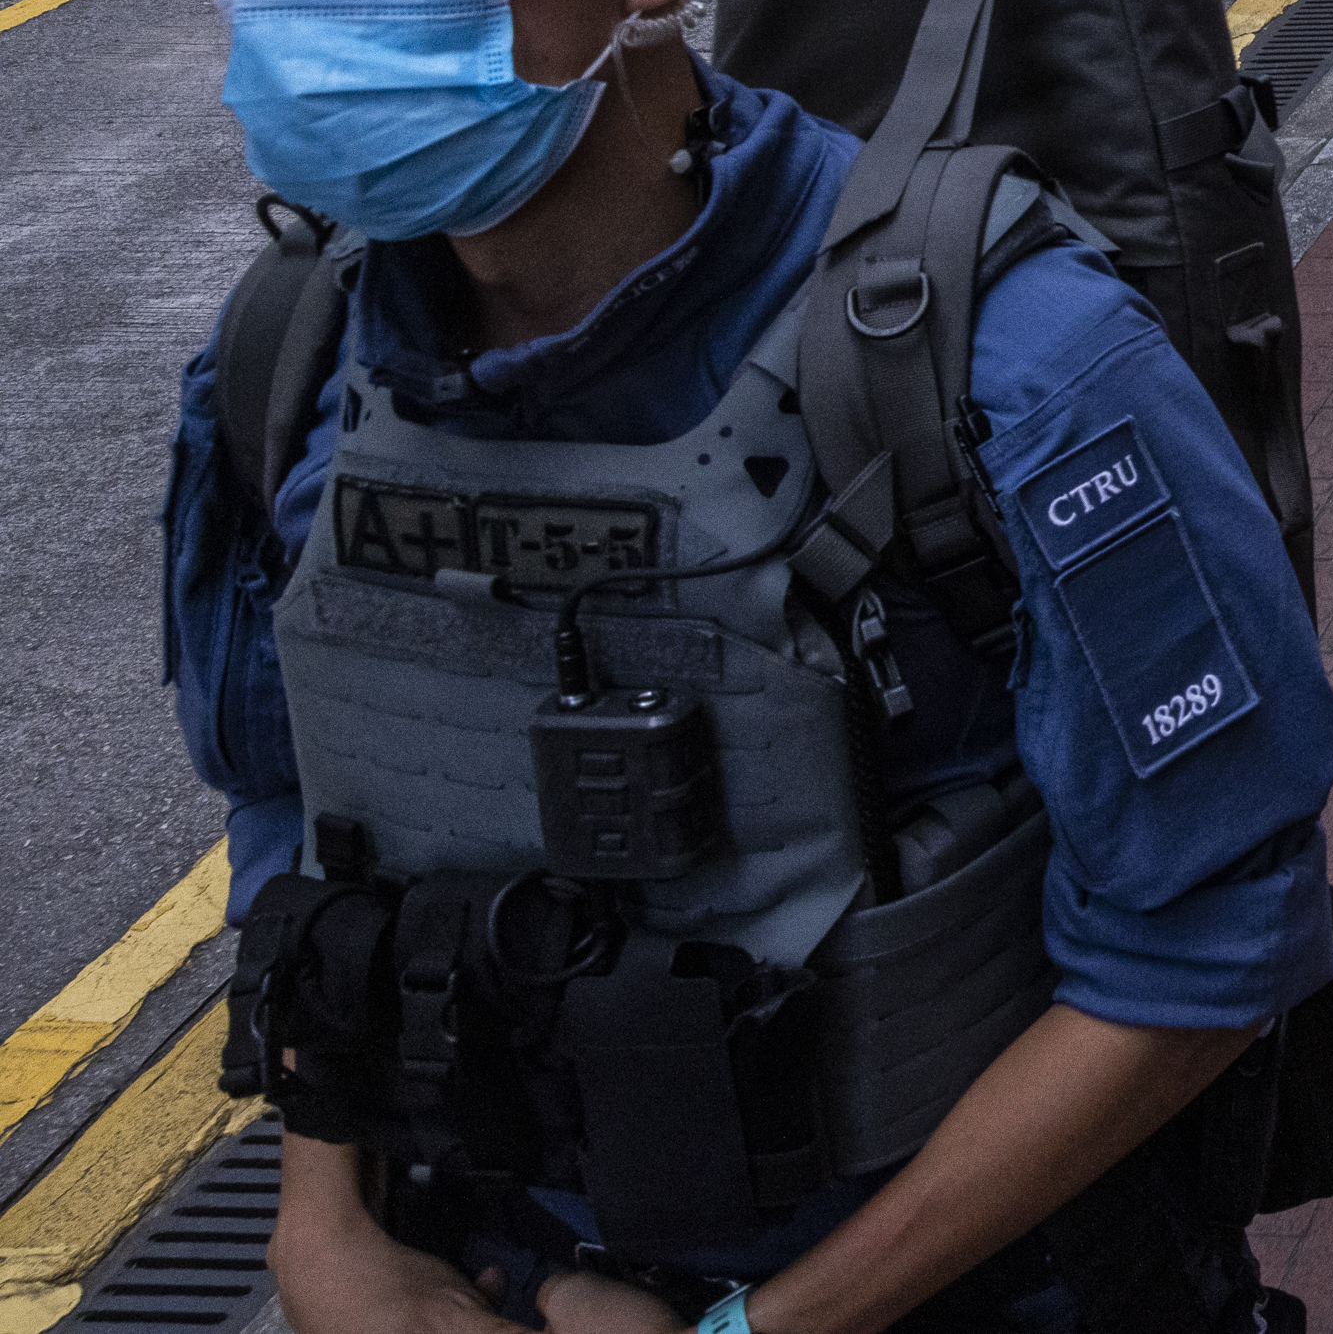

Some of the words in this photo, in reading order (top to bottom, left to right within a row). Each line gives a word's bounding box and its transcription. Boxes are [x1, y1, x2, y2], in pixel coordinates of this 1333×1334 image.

[1047, 455, 1138, 527] CTRU
[349, 490, 456, 574] A+
[1141, 674, 1223, 745] 18289
